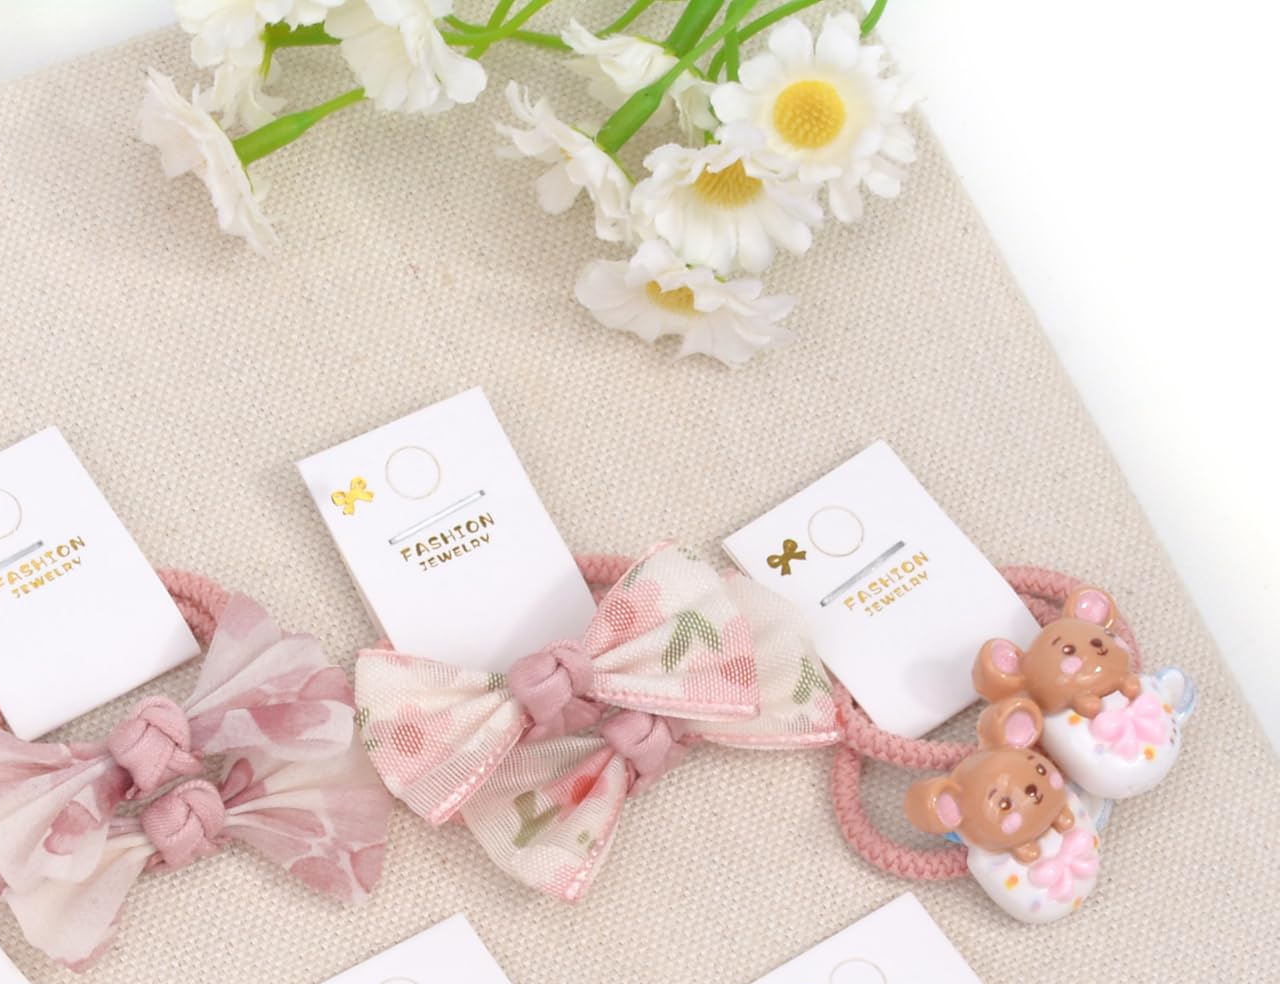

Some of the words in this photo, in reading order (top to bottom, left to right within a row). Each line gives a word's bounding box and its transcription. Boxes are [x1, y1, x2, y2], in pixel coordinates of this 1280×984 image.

[400, 512, 495, 562] FASHION
[419, 533, 490, 572] JEWELRY
[11, 556, 81, 599] JEWELRY
[843, 551, 928, 610] FASHION
[864, 570, 928, 616] JEWELRY
